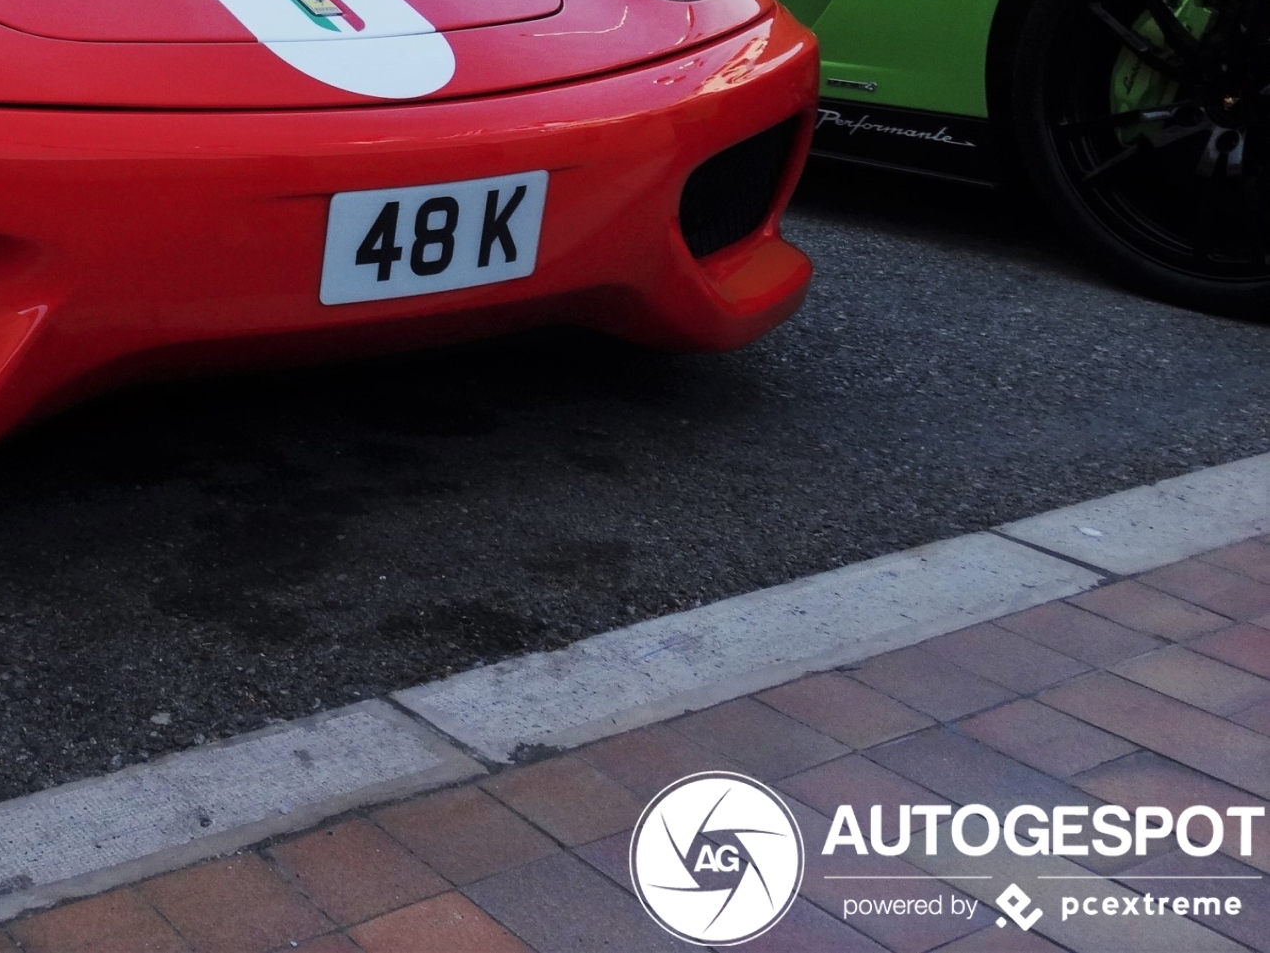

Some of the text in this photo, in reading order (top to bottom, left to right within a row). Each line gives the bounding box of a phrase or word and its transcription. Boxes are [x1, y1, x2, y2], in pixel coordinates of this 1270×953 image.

[816, 108, 977, 146] Performante
[356, 185, 527, 281] 48 K
